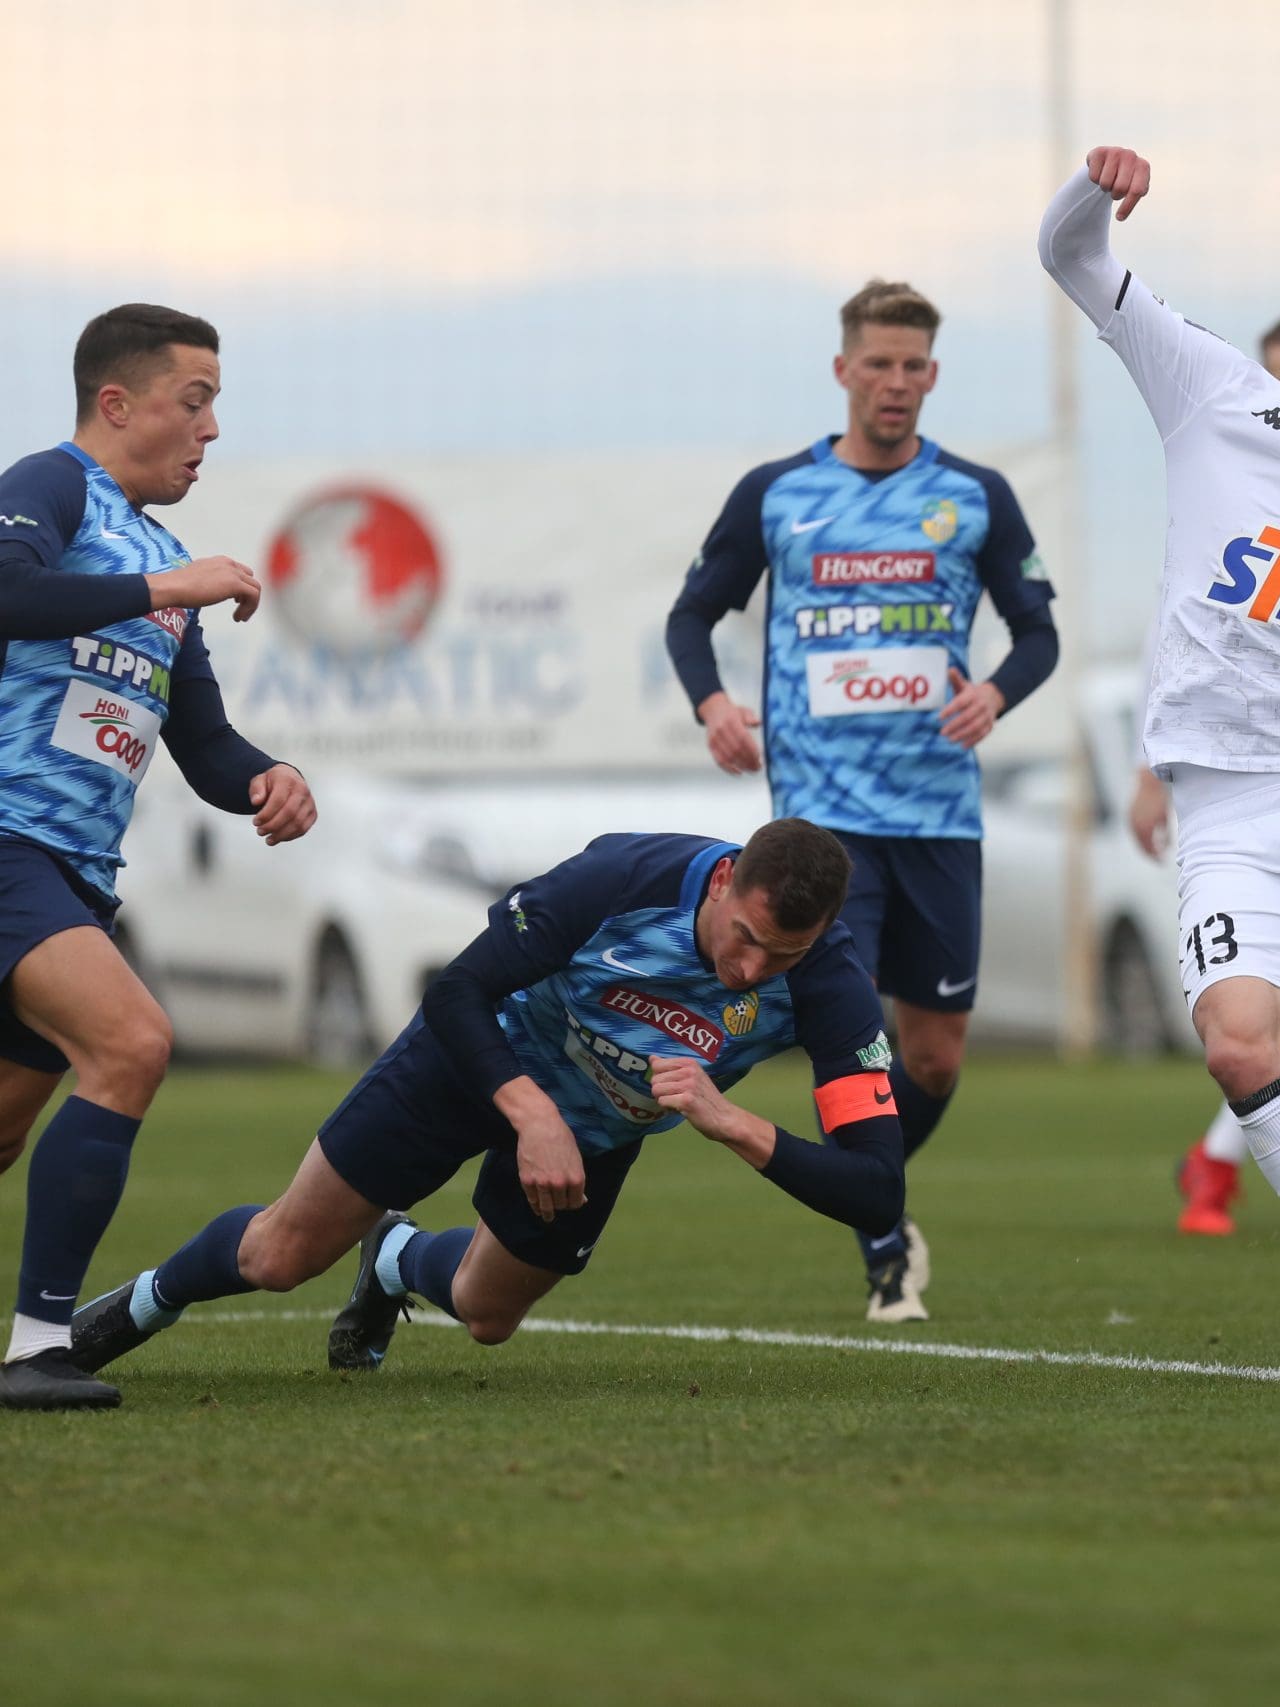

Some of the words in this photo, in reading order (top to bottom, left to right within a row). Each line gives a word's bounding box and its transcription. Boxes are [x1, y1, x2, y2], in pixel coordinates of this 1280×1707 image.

[820, 555, 929, 580] HUNGAST
[72, 636, 171, 702] TiPPM
[95, 698, 129, 720] HONI
[1186, 912, 1239, 977] 13
[606, 990, 719, 1053] HUNGAST
